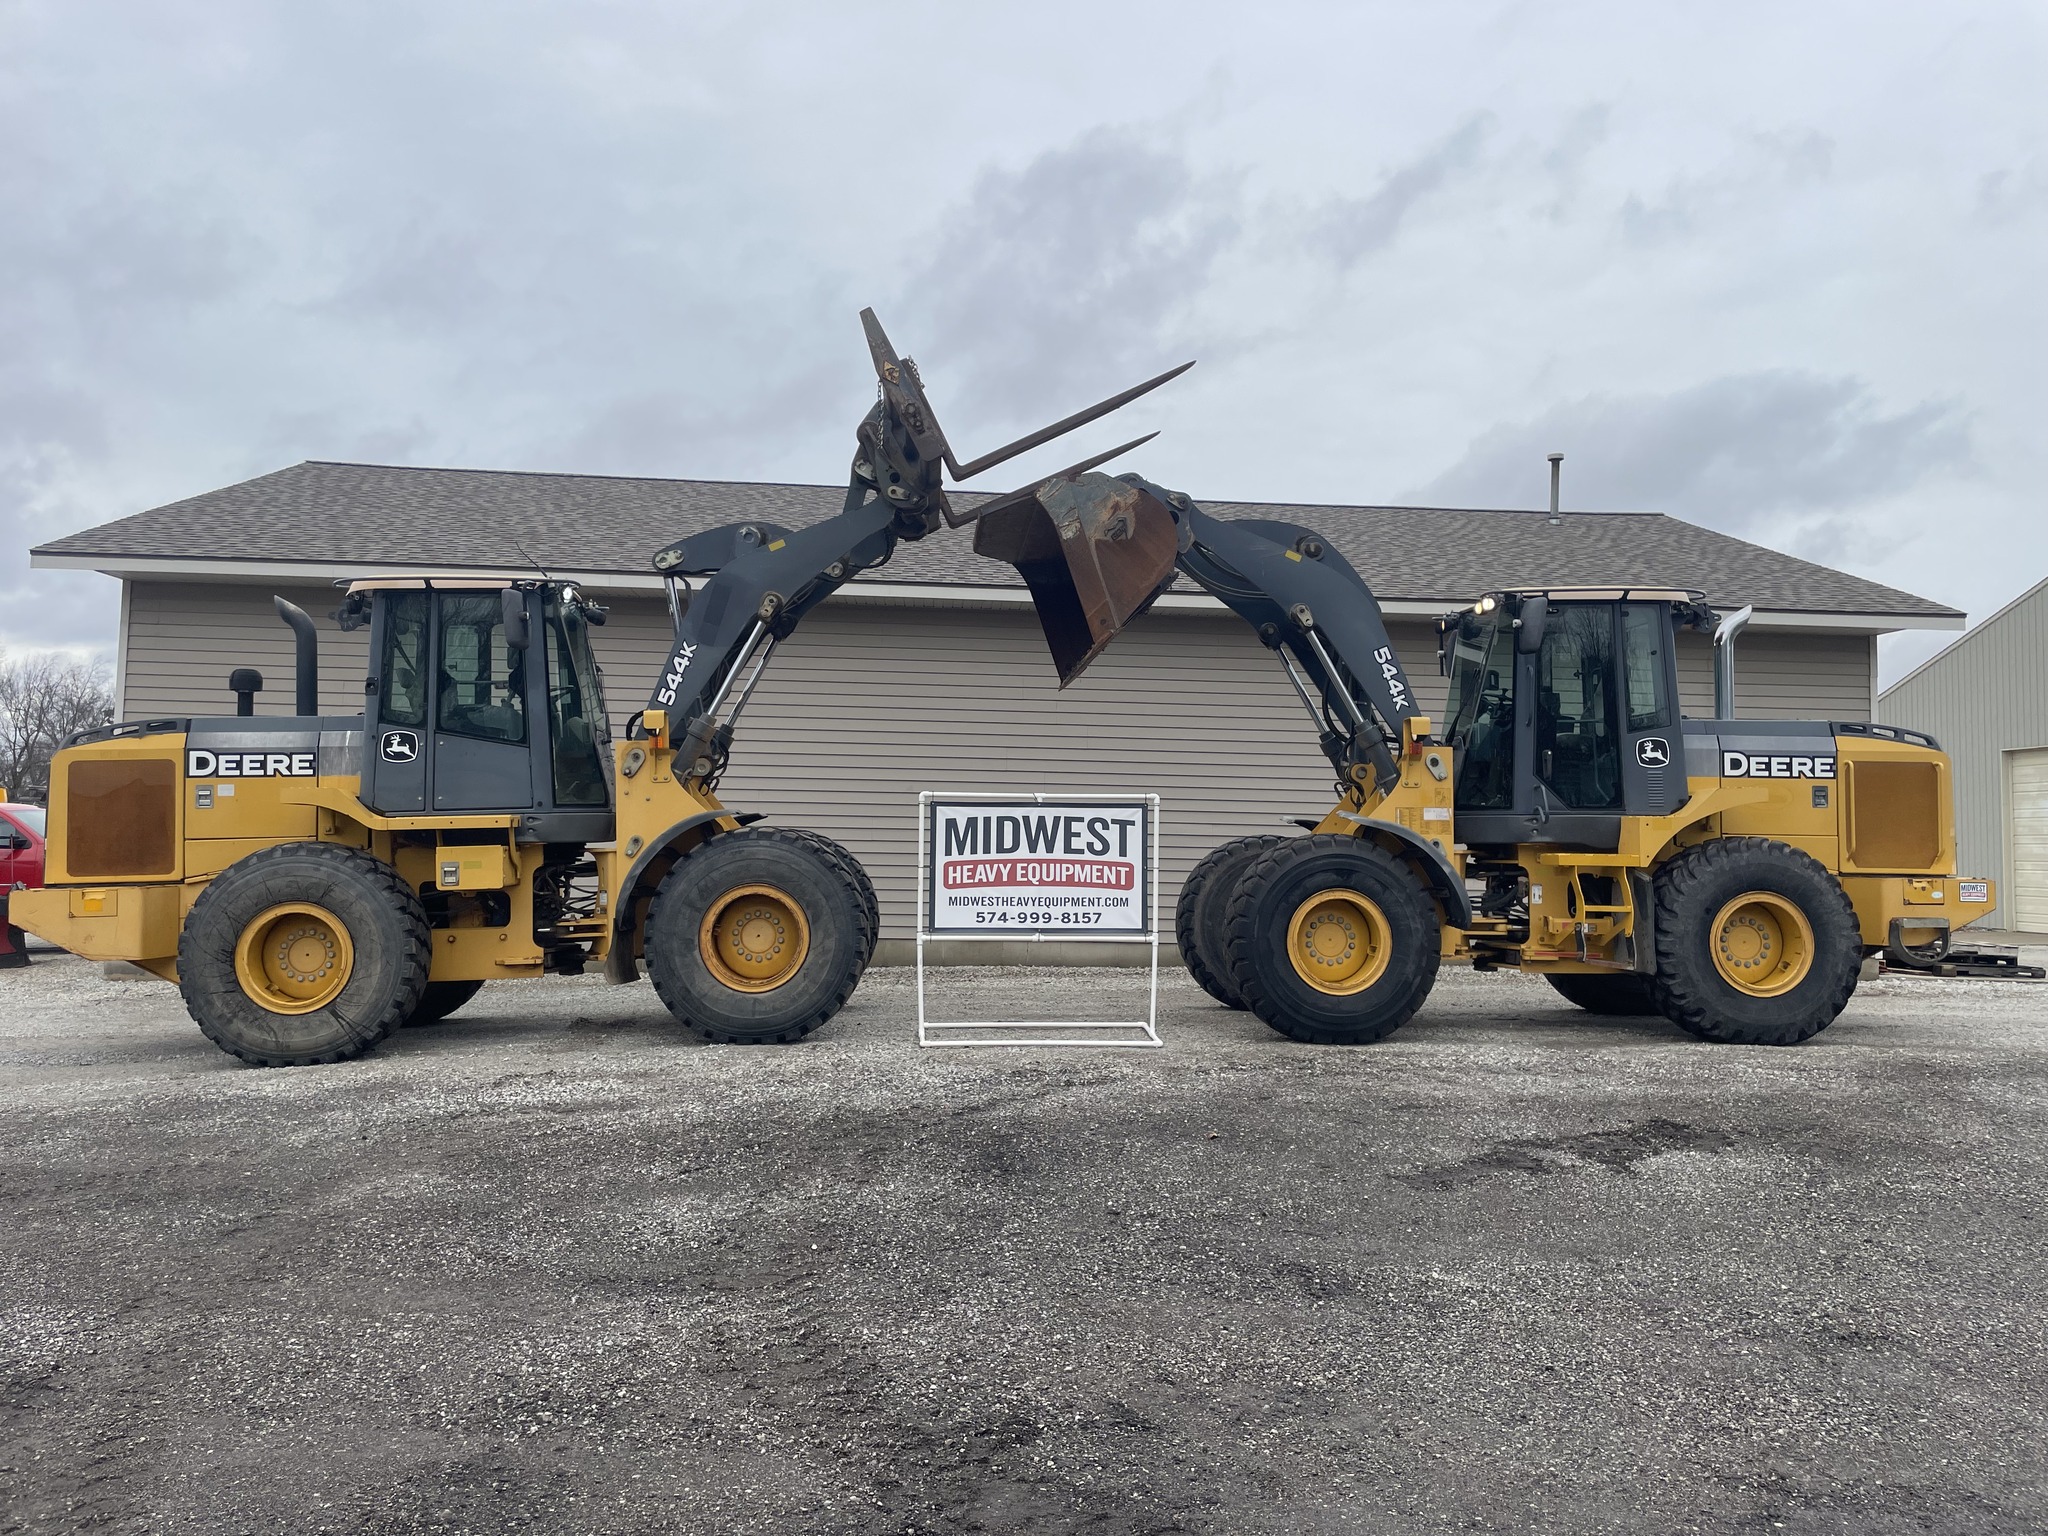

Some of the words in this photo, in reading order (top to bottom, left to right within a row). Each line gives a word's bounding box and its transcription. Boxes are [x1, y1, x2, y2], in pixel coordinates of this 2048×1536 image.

[656, 640, 699, 707] 544K
[1373, 646, 1410, 712] 544K
[188, 750, 314, 777] DEERE
[1724, 752, 1835, 778] DEERE
[944, 815, 1136, 857] MIDWEST
[948, 863, 1012, 885] HEAVY
[1016, 863, 1130, 885] EQUIPMENT
[1961, 884, 1985, 892] MIDWEST
[948, 896, 1129, 908] MIDWESTHEAVYEQUIPMENT.COM
[975, 912, 1102, 924] 574-999-8157
